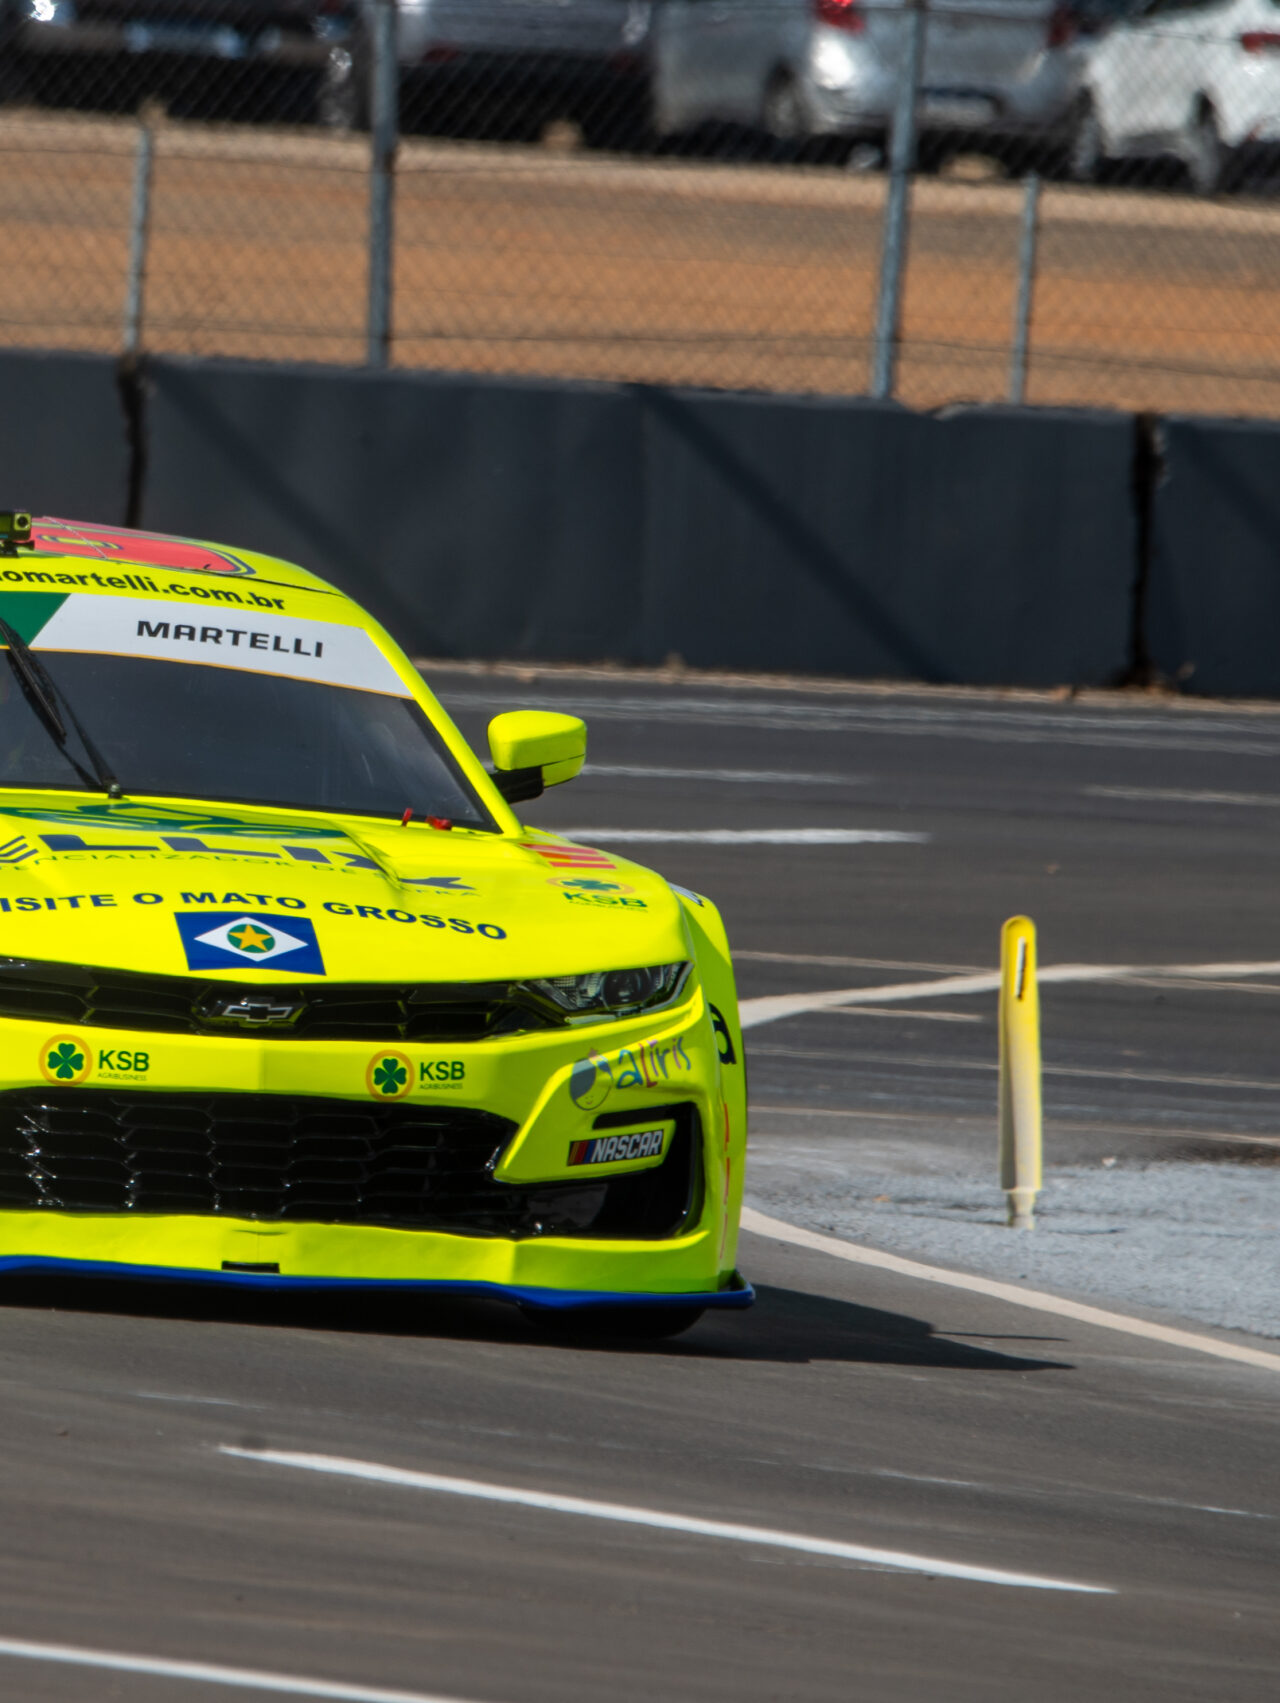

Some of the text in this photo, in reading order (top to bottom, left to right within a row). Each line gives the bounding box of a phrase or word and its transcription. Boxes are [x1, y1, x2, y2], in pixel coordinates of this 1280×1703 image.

[136, 620, 324, 659] MARTELLI
[562, 891, 649, 908] KSB
[132, 892, 164, 905] O
[179, 891, 308, 910] MATO
[322, 901, 508, 940] GROSSO
[98, 1049, 150, 1072] KSB
[419, 1060, 465, 1081] KSB
[589, 1130, 664, 1164] NASCAR
